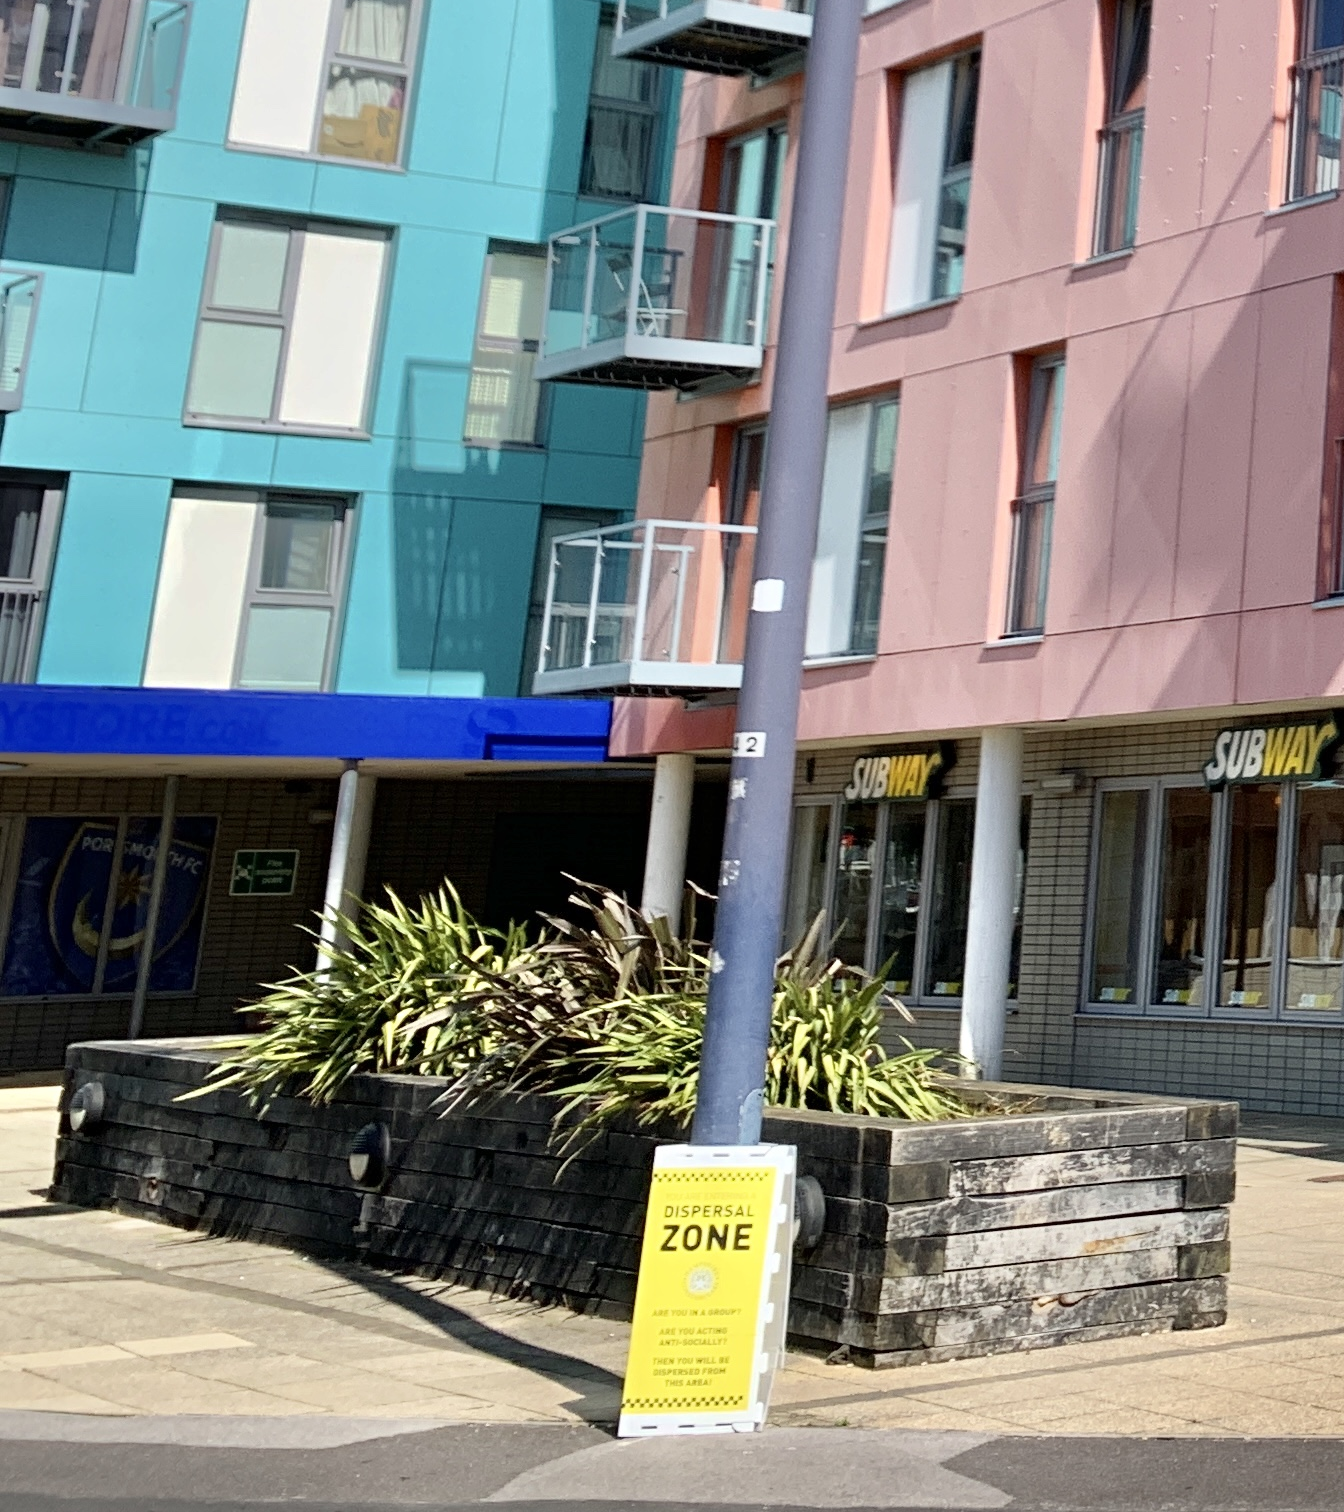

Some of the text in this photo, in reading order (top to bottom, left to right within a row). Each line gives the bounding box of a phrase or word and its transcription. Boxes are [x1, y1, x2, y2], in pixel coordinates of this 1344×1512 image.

[1205, 721, 1337, 780] SUBWAY
[845, 752, 942, 800] SUBWAY
[664, 1205, 755, 1219] DISPERSAL
[660, 1223, 754, 1252] ZONE
[652, 1309, 669, 1317] ARE
[671, 1309, 688, 1317] YOU
[659, 1326, 729, 1336] ARE YOU ACTING
[653, 1357, 675, 1366] THEN
[677, 1357, 694, 1366] YOU
[696, 1356, 717, 1365] WILL
[653, 1367, 727, 1377] DISPERSED FROM
[665, 1379, 684, 1388] THIS
